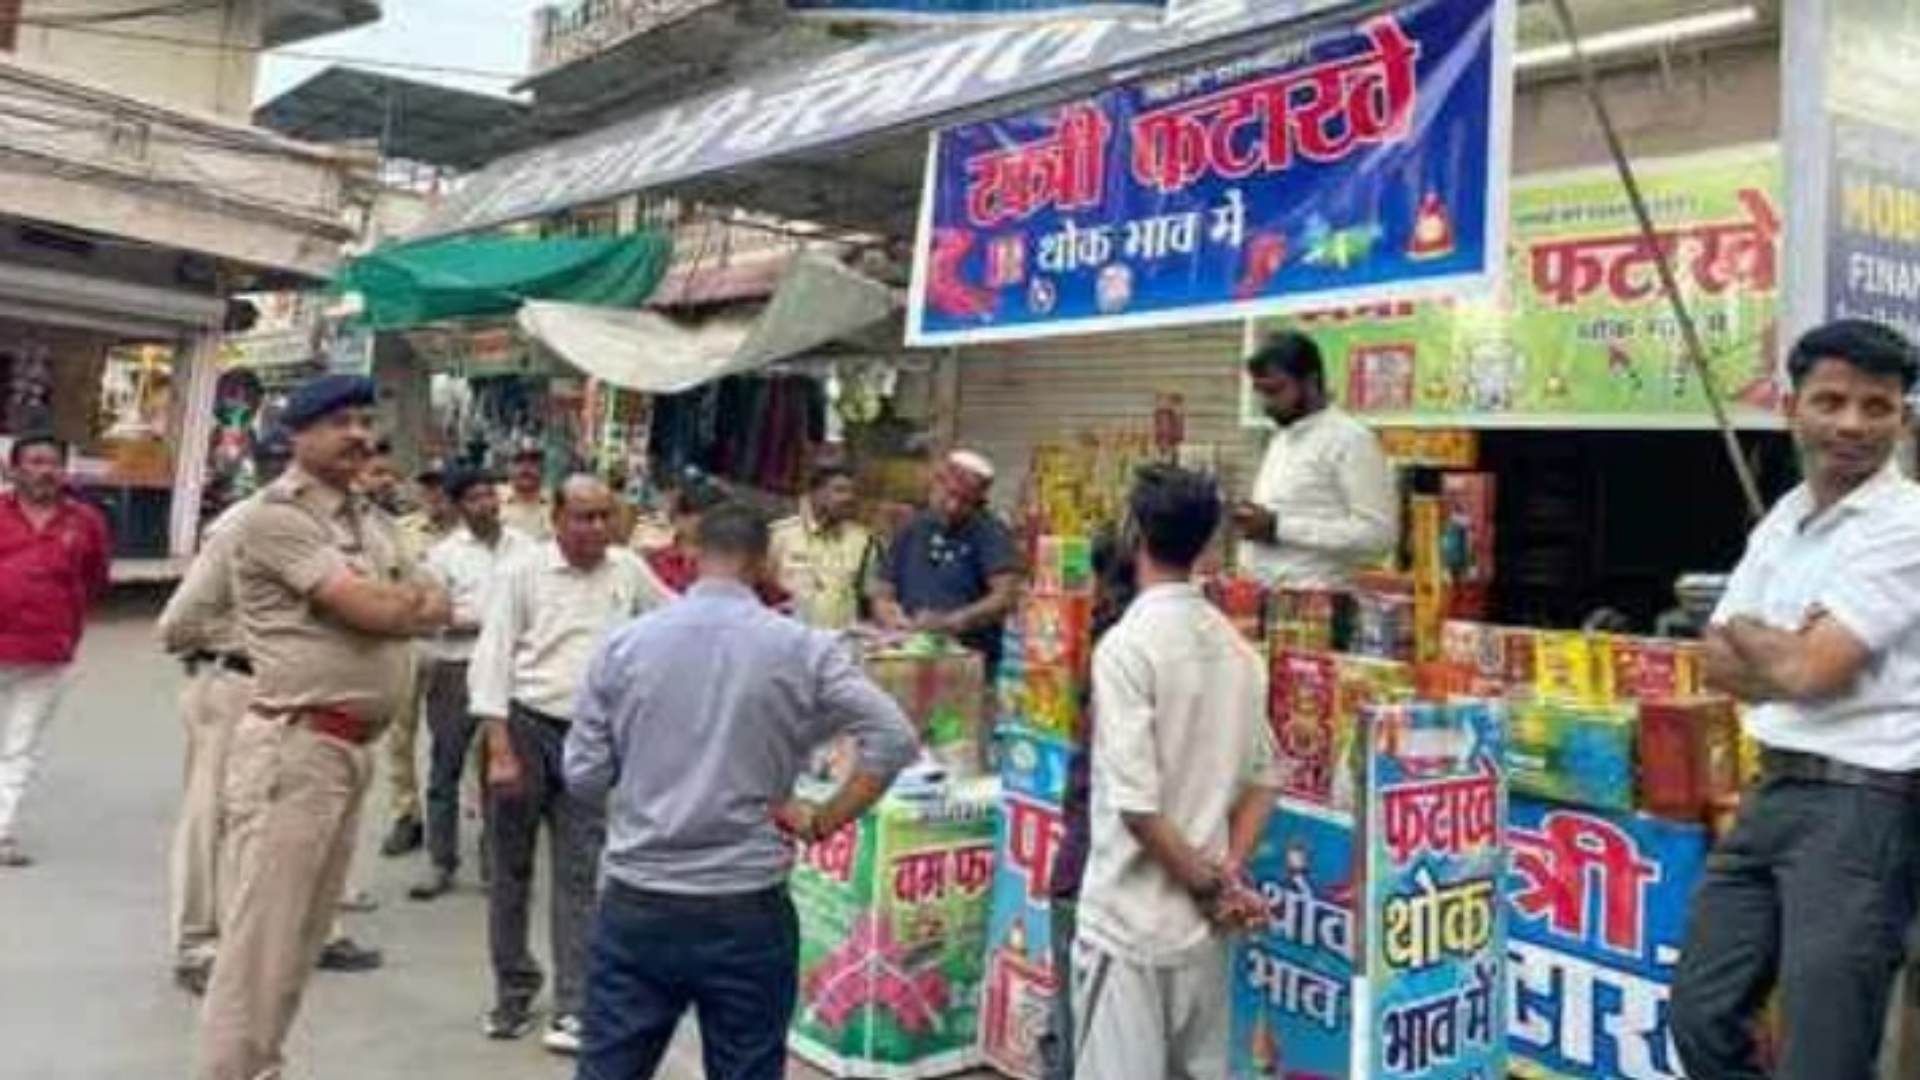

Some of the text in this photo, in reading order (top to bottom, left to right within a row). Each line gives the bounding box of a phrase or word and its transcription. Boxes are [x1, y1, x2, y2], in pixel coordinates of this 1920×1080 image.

[1131, 14, 1421, 192] फटाखे
[1037, 218, 1112, 272] थोक
[1122, 210, 1202, 262] भाव
[1384, 868, 1494, 966] थोक
[1246, 948, 1345, 1030] भाव
[1384, 994, 1458, 1072] भाव
